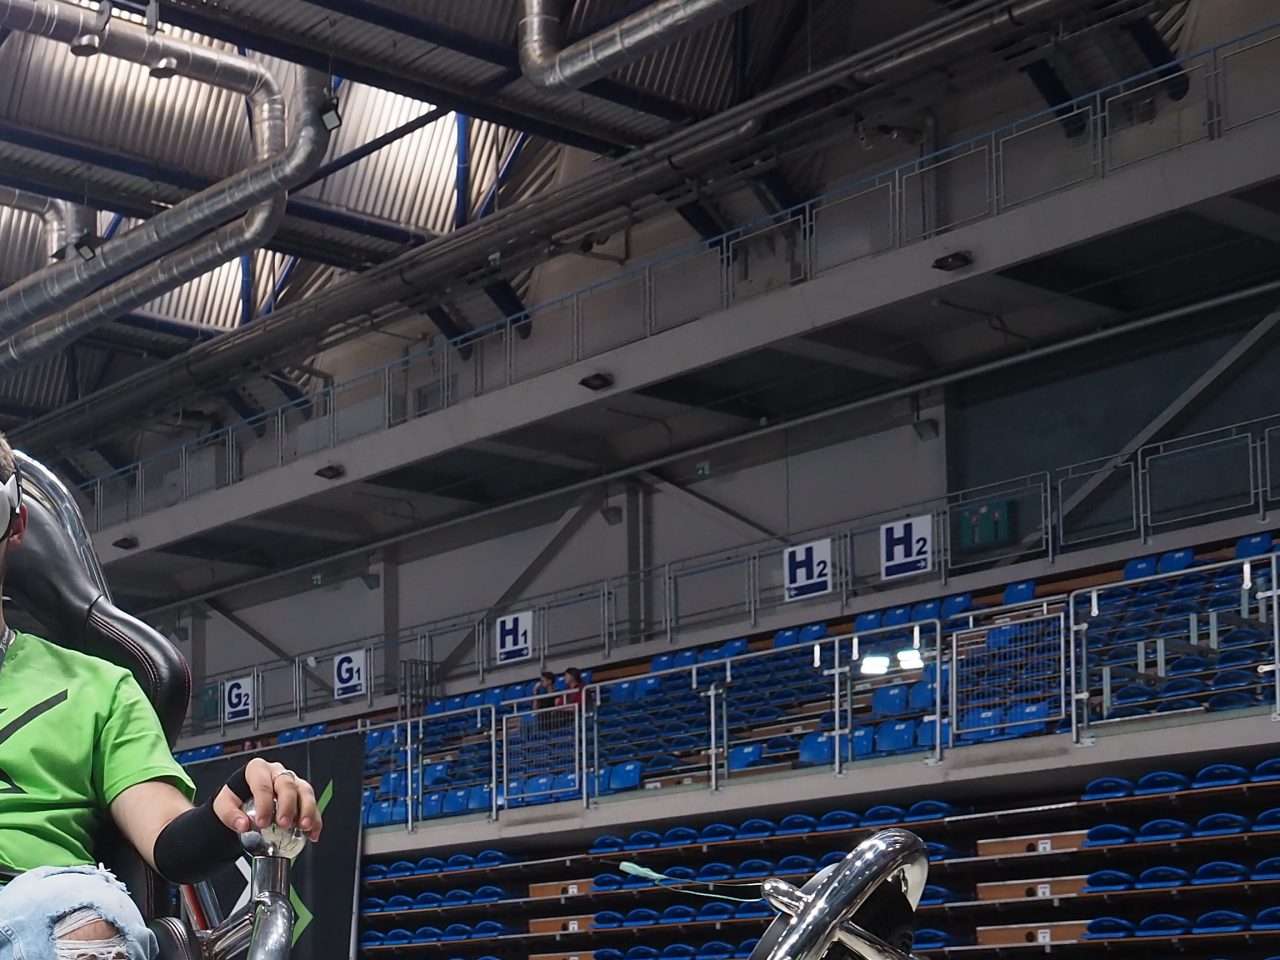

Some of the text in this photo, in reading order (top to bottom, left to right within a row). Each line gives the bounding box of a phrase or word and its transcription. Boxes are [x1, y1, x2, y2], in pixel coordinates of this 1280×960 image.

[885, 522, 928, 563] H2
[788, 546, 828, 585] H2
[500, 616, 528, 649] H1
[336, 656, 361, 685] G1
[227, 682, 250, 710] G2
